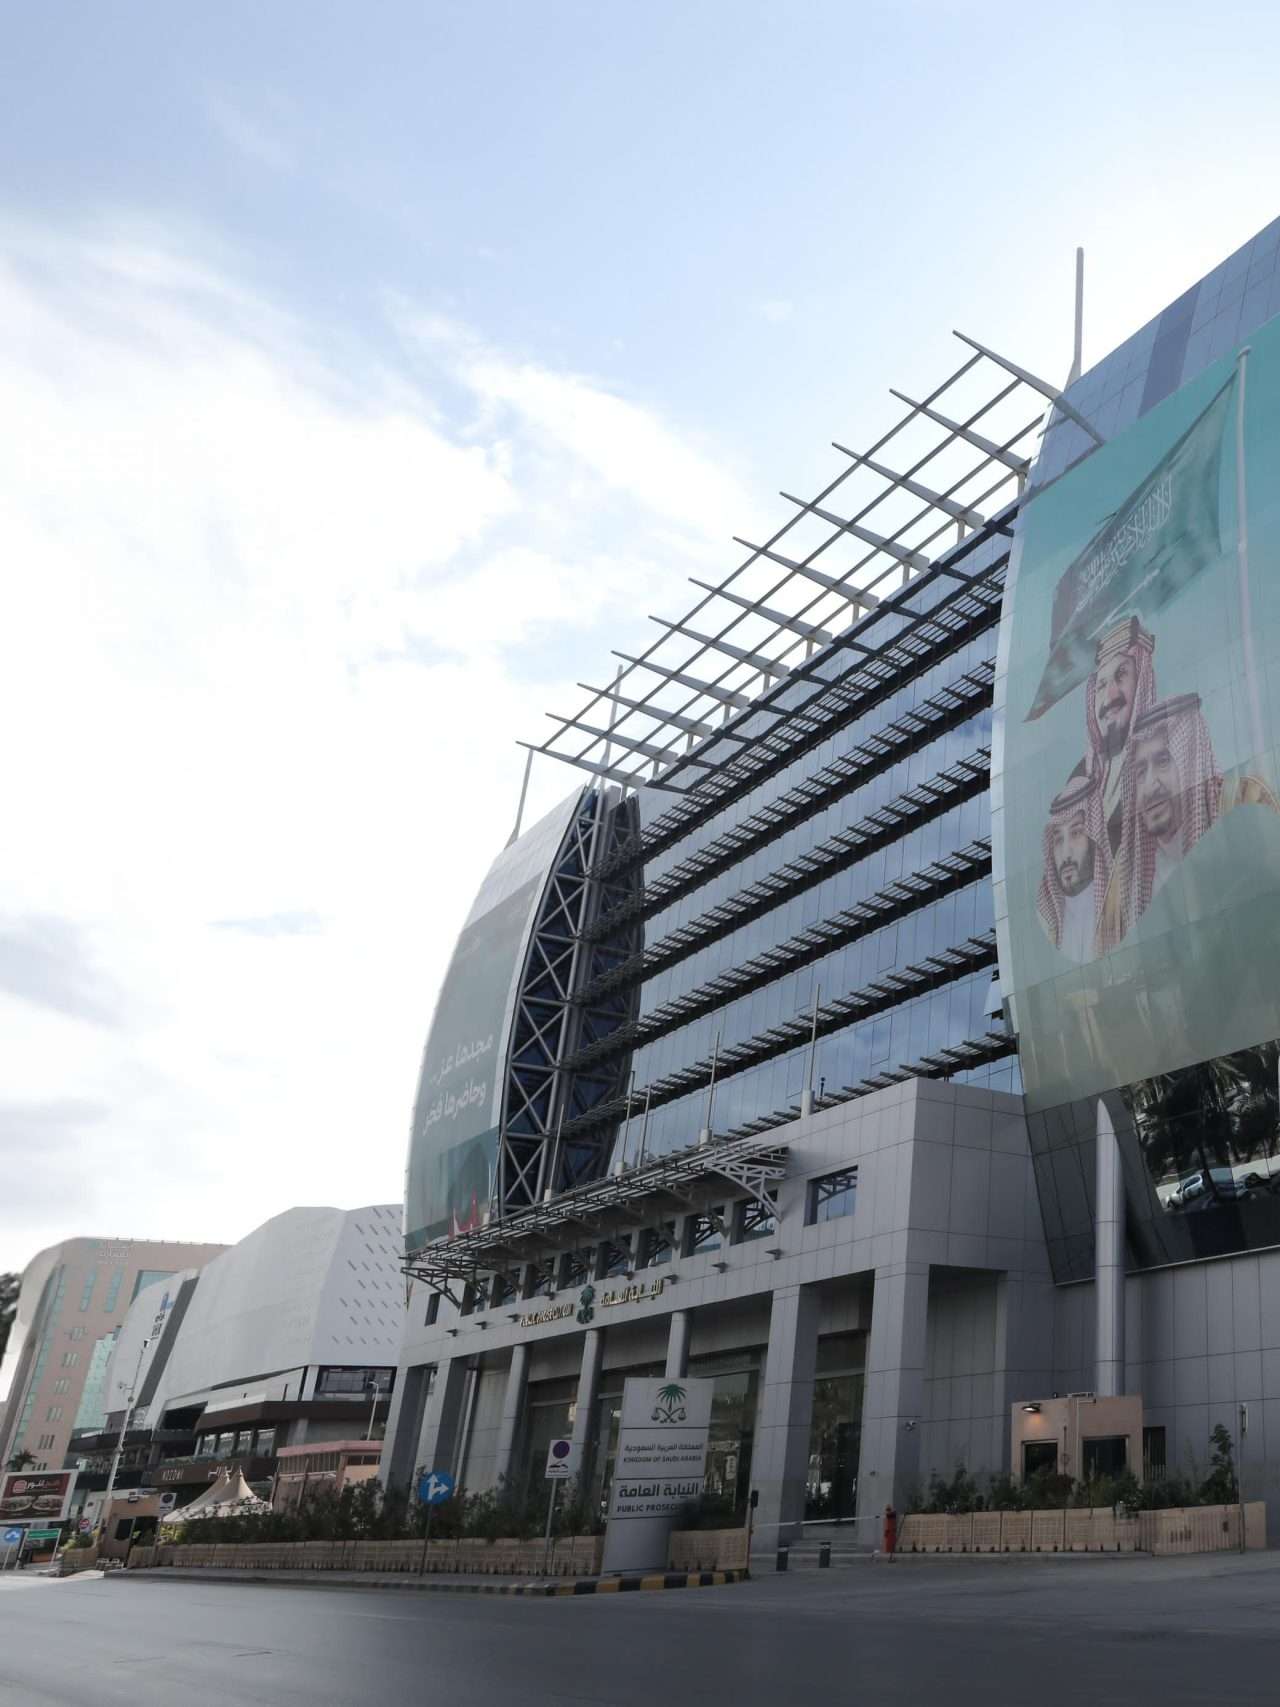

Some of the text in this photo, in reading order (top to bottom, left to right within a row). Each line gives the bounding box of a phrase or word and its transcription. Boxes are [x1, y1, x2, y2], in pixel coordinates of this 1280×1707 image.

[618, 1481, 699, 1500] النيابة العامة
[617, 1504, 644, 1513] PUBLIC
